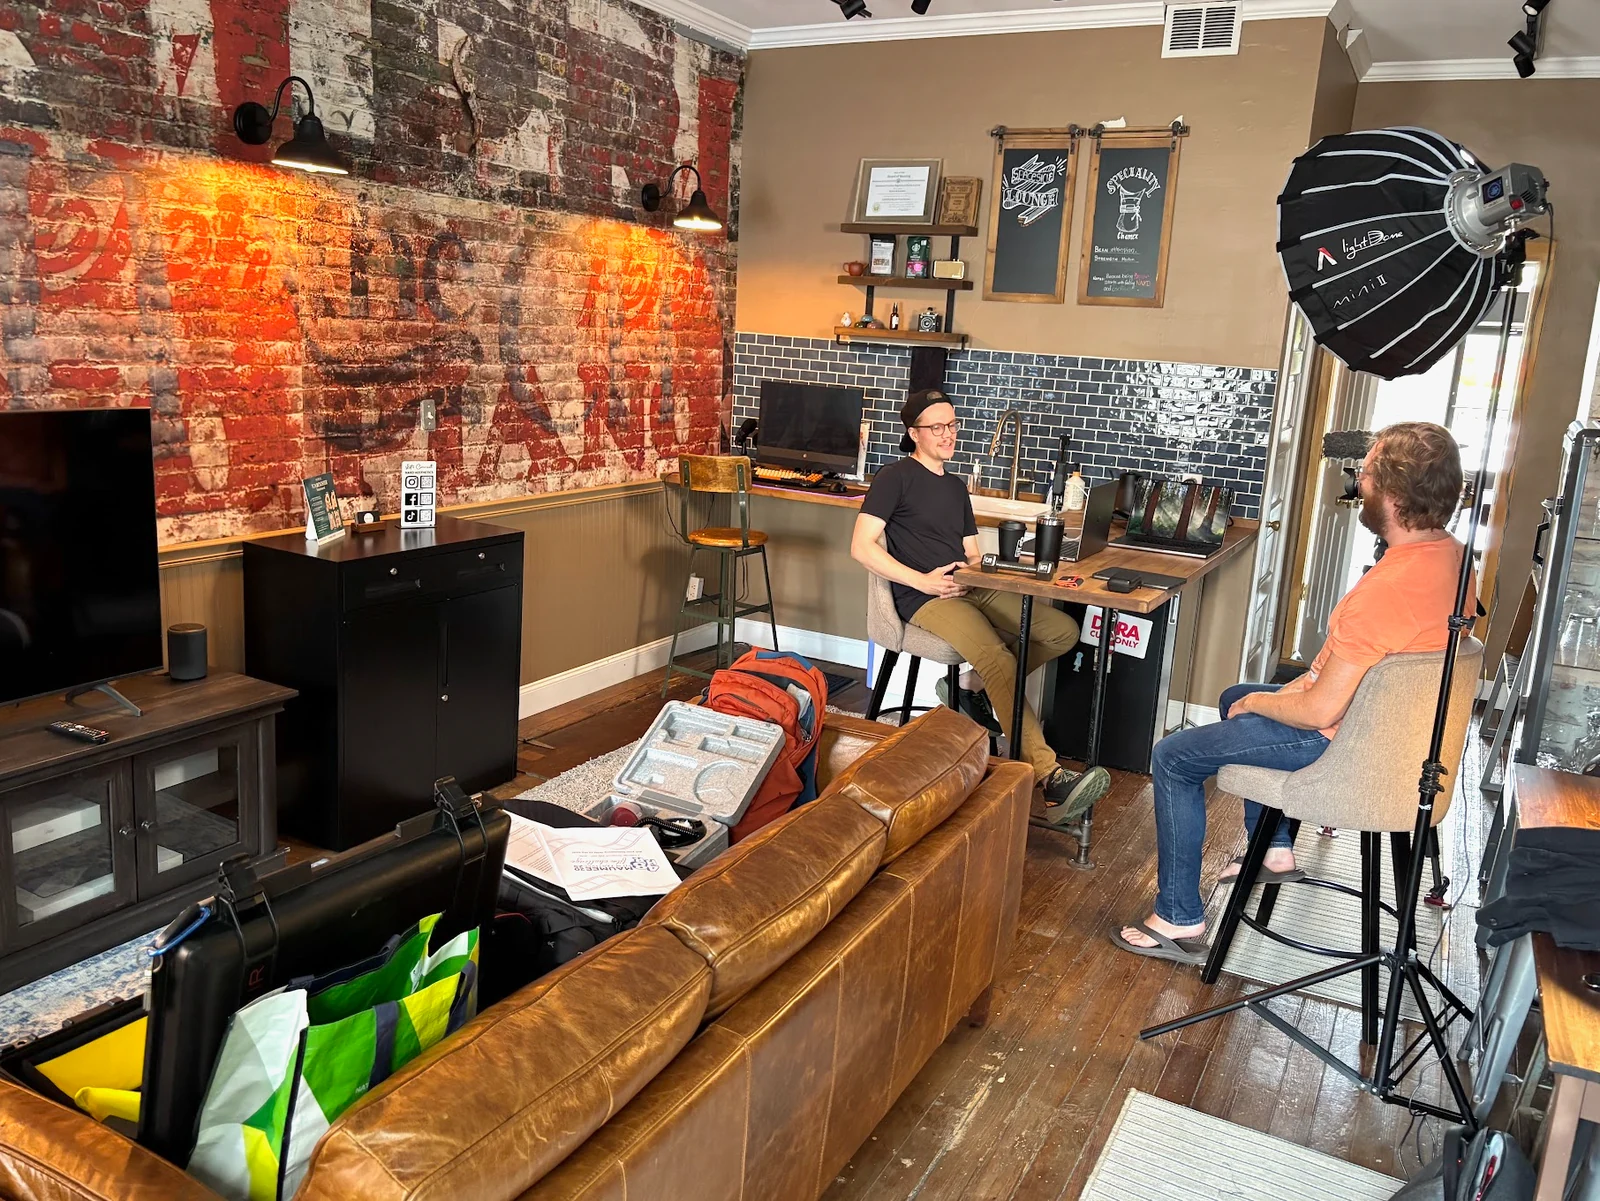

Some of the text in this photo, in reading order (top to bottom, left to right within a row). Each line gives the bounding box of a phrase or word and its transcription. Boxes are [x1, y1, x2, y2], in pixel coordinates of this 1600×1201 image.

[1006, 189, 1056, 206] LOUNGE
[1091, 614, 1140, 641] DRA
[1114, 637, 1139, 649] ONLY
